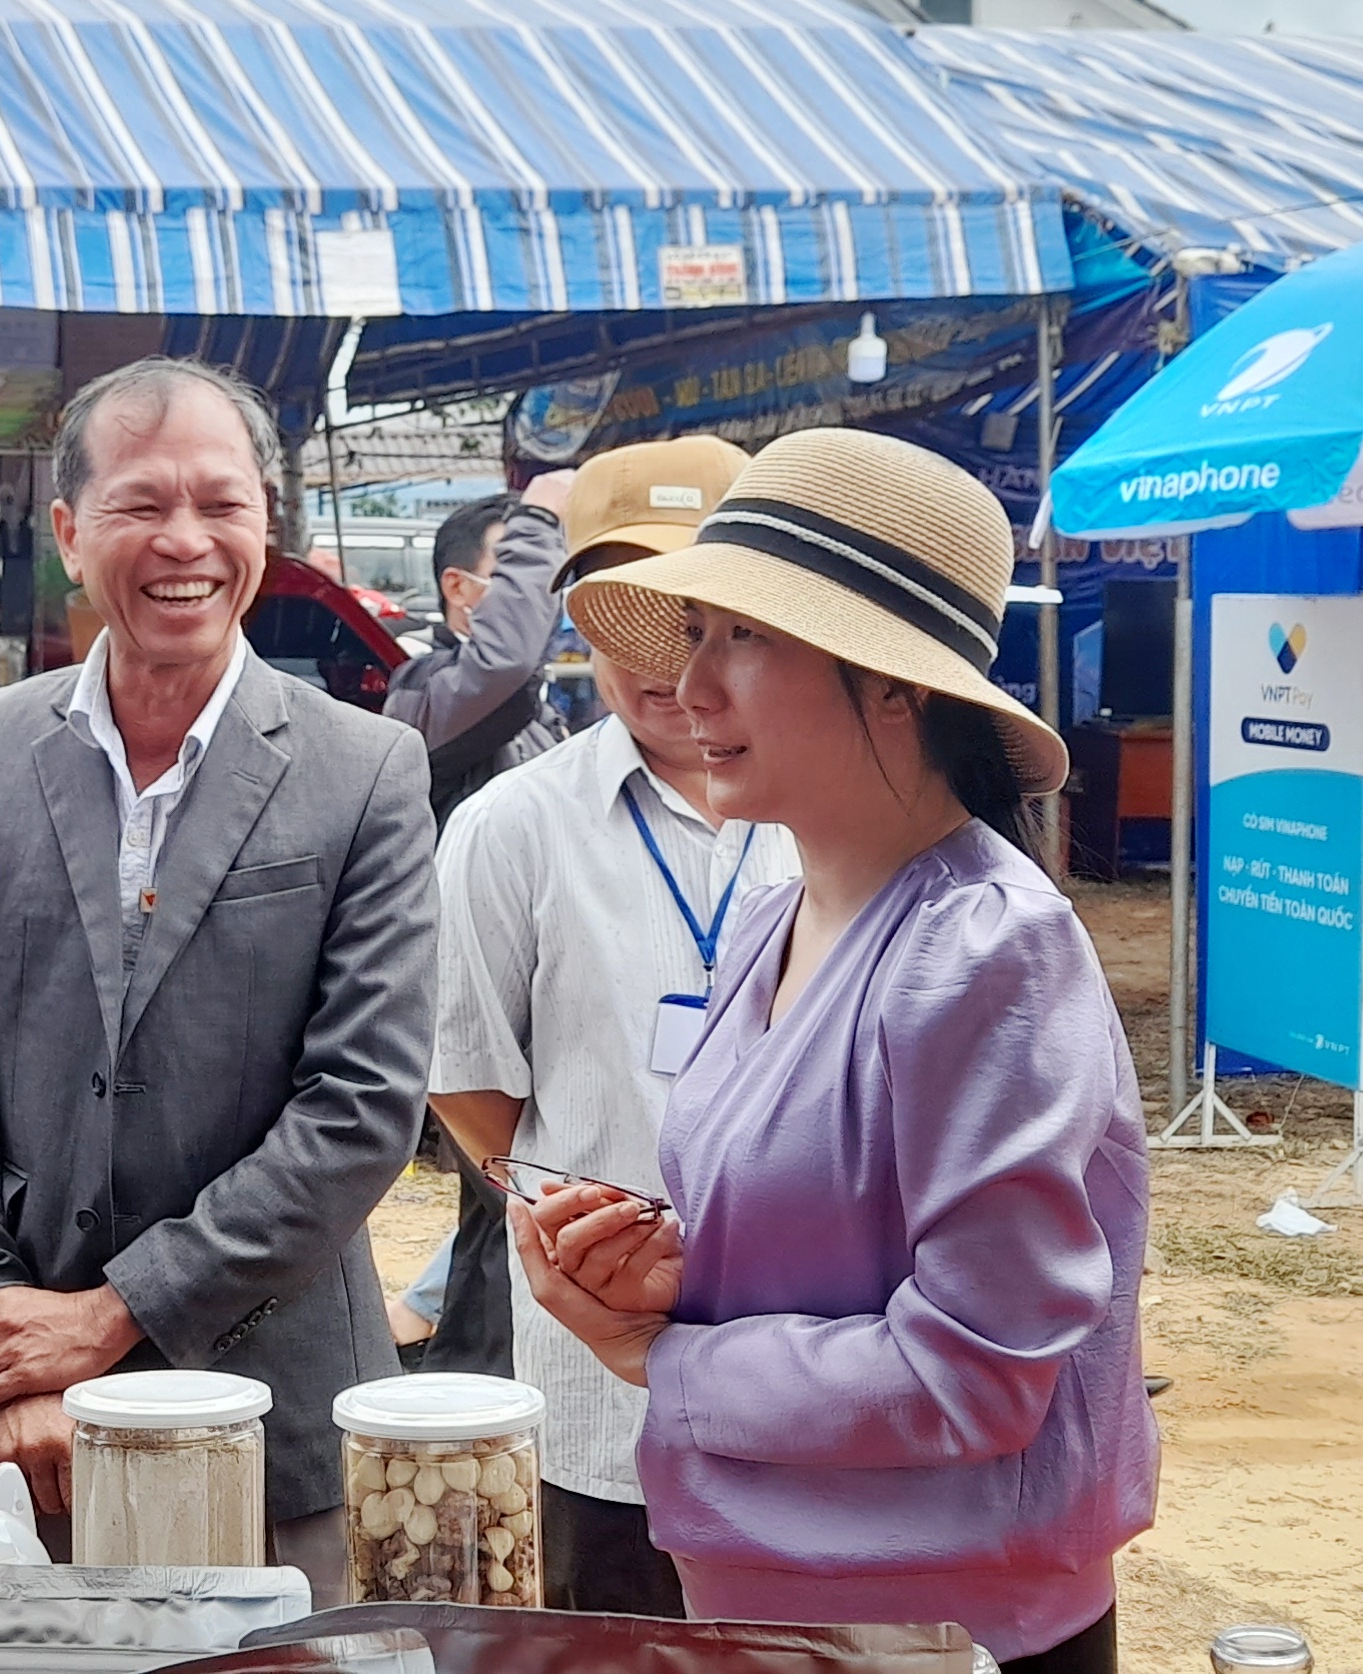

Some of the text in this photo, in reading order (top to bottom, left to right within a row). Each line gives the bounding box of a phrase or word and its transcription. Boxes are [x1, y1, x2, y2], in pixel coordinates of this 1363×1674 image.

[1200, 393, 1282, 418] VNPT
[1120, 459, 1281, 503] vinaphone
[1249, 722, 1323, 746] MOBILE MONEY
[1259, 815, 1275, 831] SIM
[1276, 818, 1328, 841] VINAPHONE
[1223, 855, 1350, 895] NẠP RÚT THANH TOÁN
[1317, 905, 1354, 931] QUỐC
